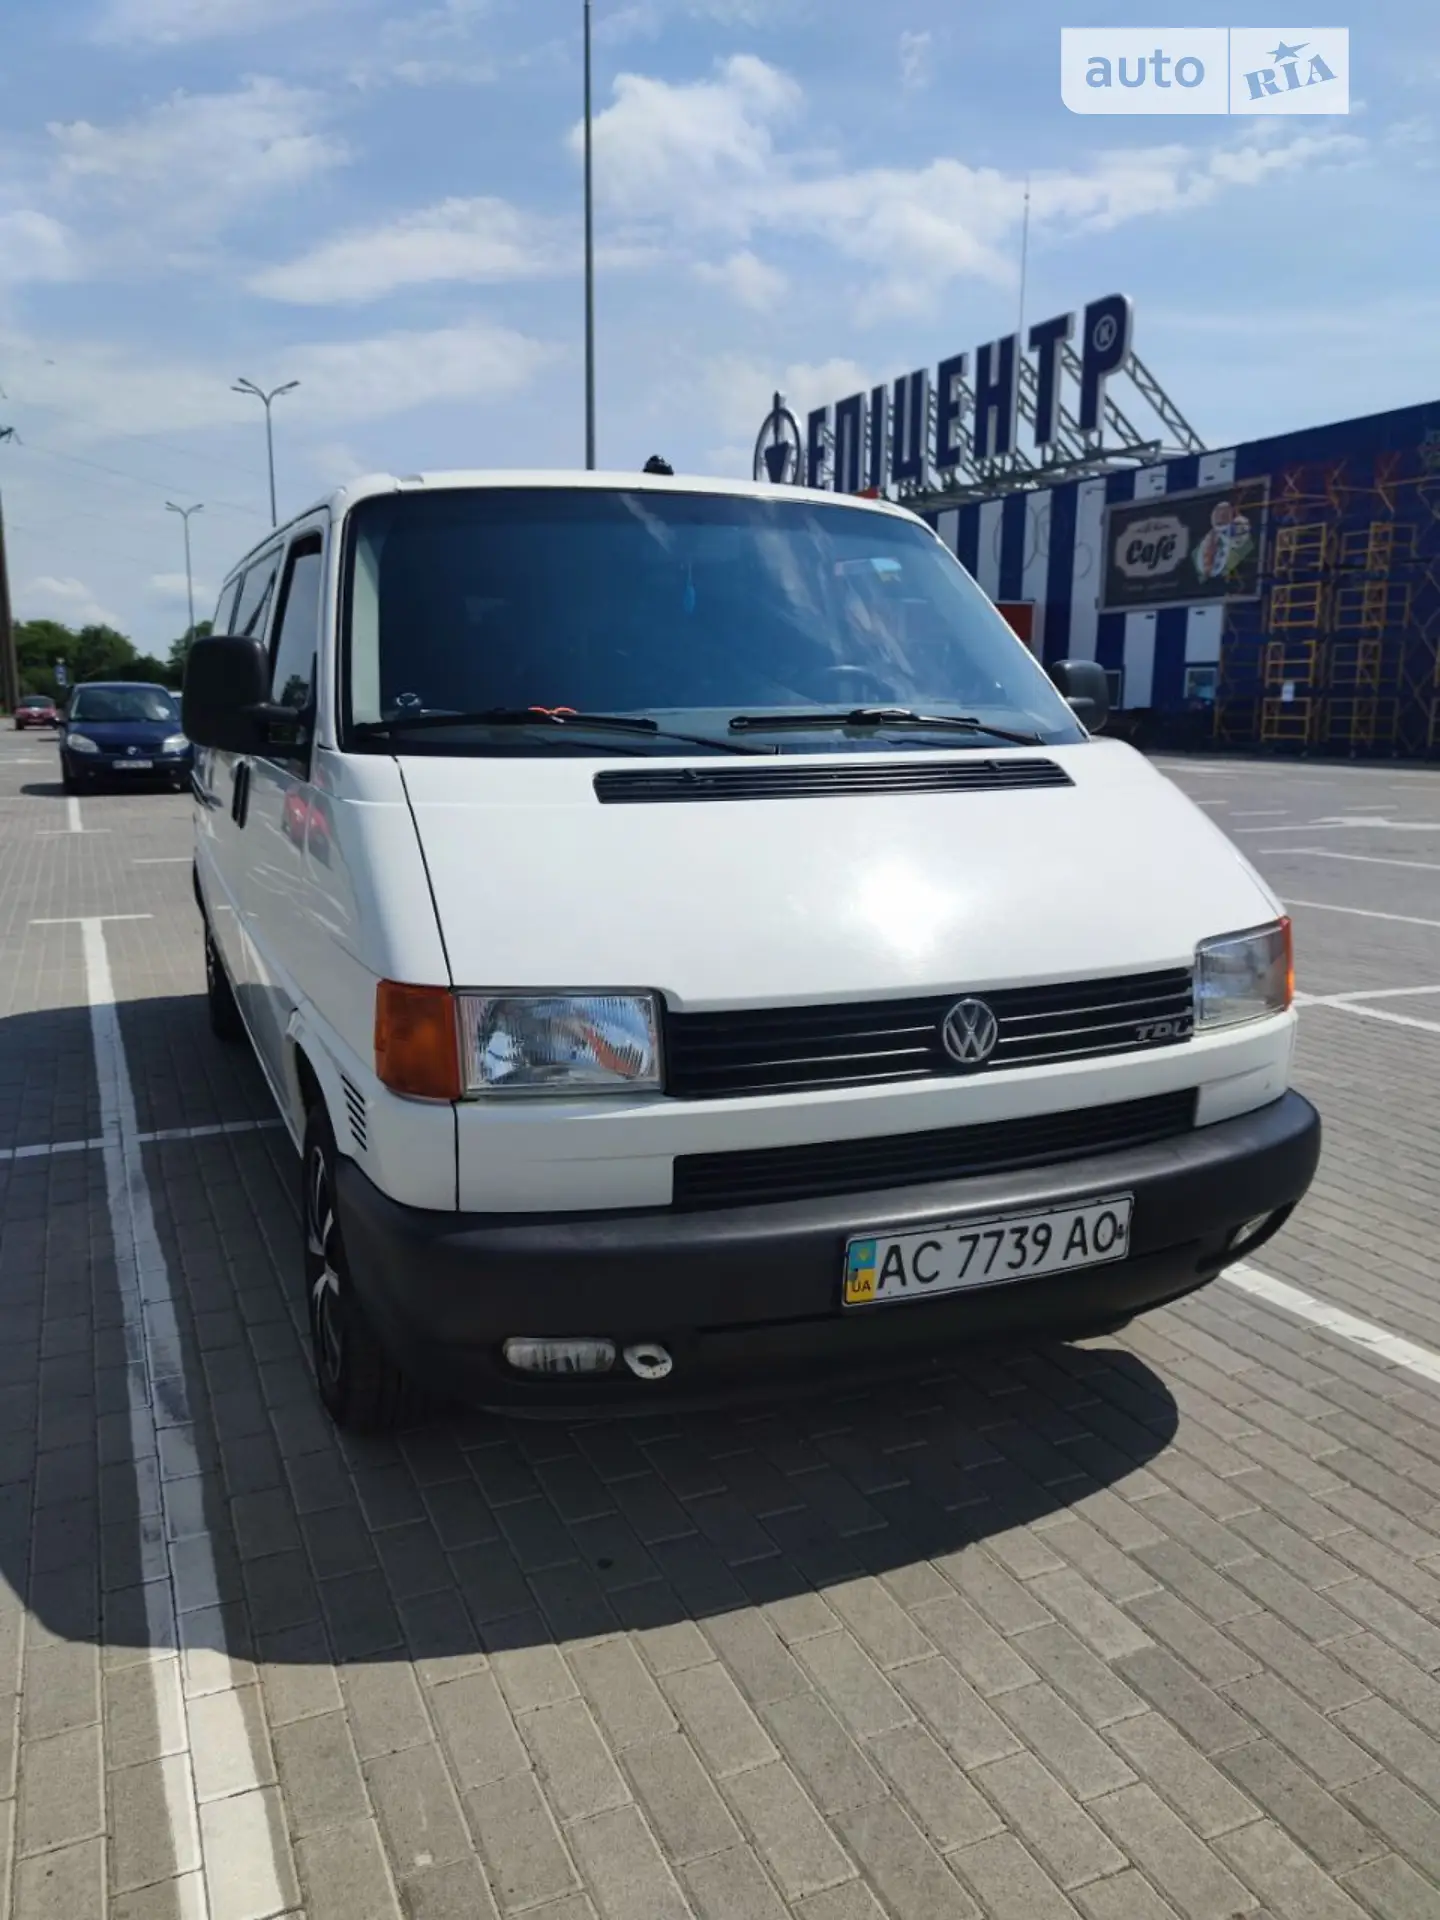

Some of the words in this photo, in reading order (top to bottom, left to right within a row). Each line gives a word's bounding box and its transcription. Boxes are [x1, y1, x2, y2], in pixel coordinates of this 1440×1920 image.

[806, 293, 1132, 492] ЕПІЦЕНТР
[1126, 533, 1178, 569] Café
[877, 1240, 942, 1289] AC
[958, 1222, 1052, 1278] 7739
[852, 1278, 871, 1293] UA
